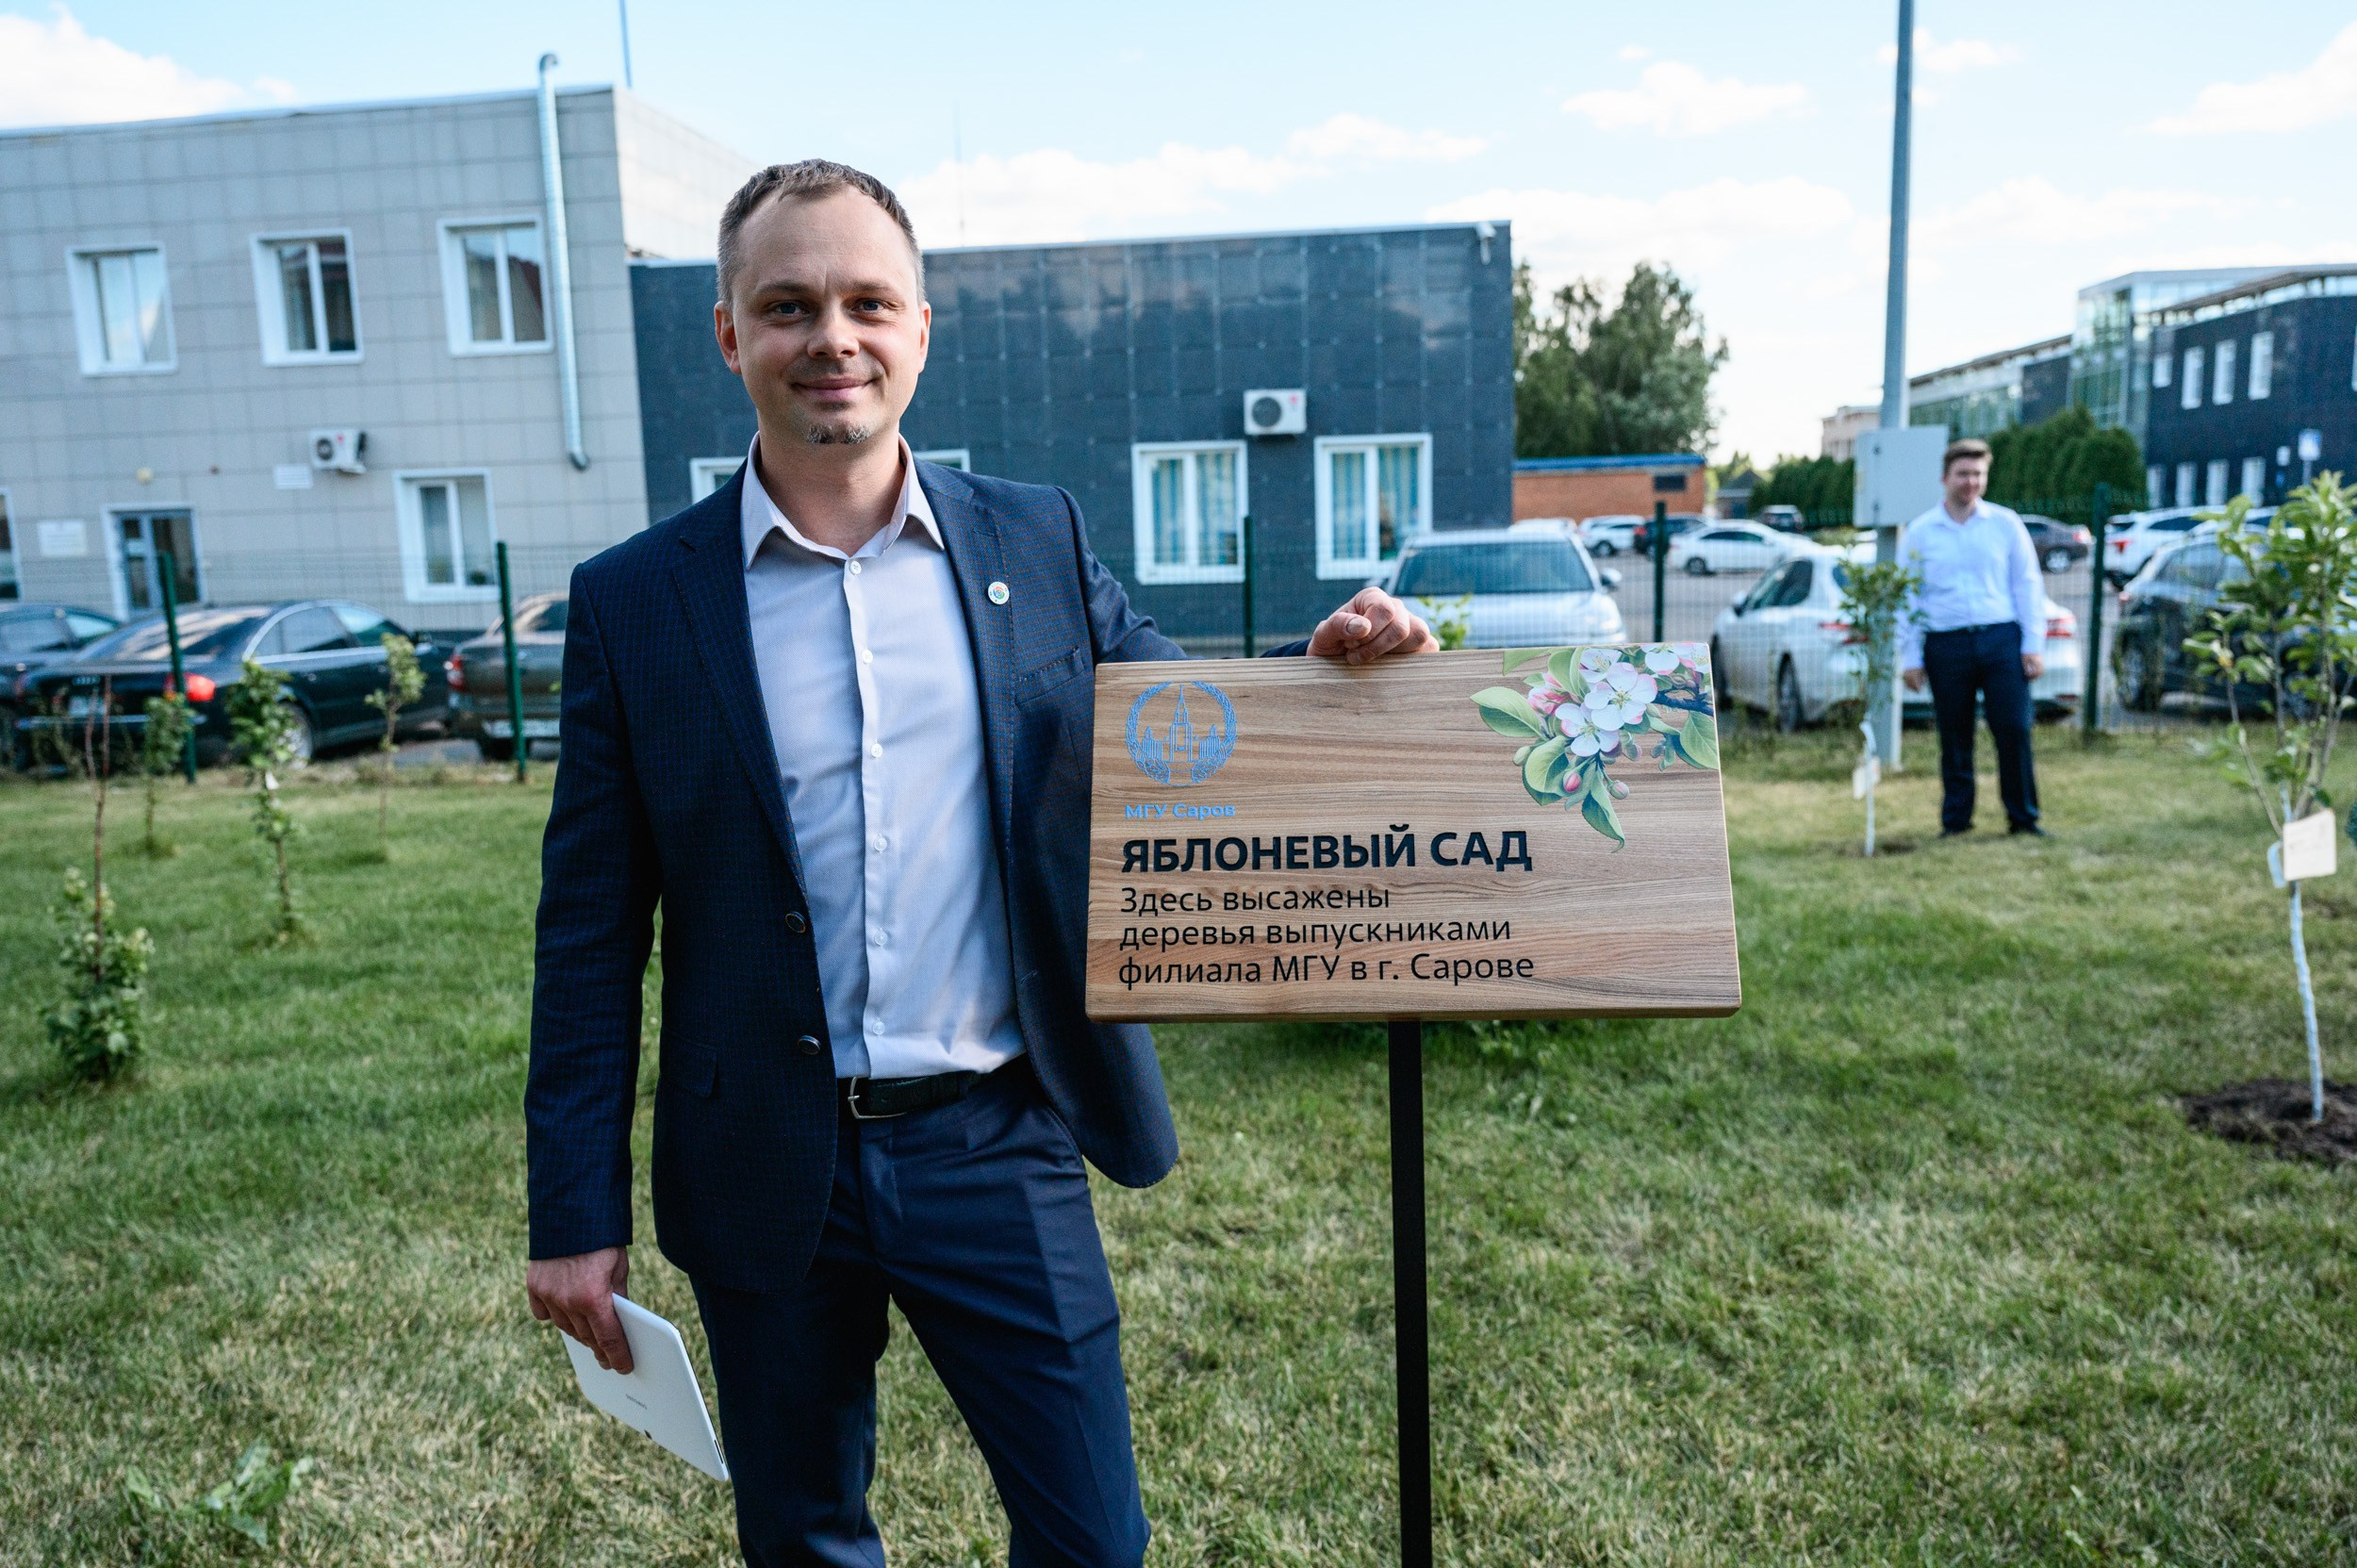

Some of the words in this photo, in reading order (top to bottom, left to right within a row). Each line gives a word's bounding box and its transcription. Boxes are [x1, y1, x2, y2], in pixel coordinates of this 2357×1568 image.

[1125, 804, 1167, 819] МГУ
[1172, 803, 1236, 821] Саров
[1121, 823, 1416, 873] ЯБЛОНЕВЫЙ
[1430, 831, 1532, 871] САД
[1120, 887, 1212, 917] Здесь
[1223, 888, 1389, 911] высажены
[1119, 925, 1255, 952] деревья
[1266, 920, 1510, 949] выпускниками
[1118, 956, 1261, 991] филиала
[1273, 954, 1341, 982] МГУ
[1351, 961, 1367, 980] в
[1379, 960, 1399, 981] г.
[1410, 953, 1534, 986] Сарове
